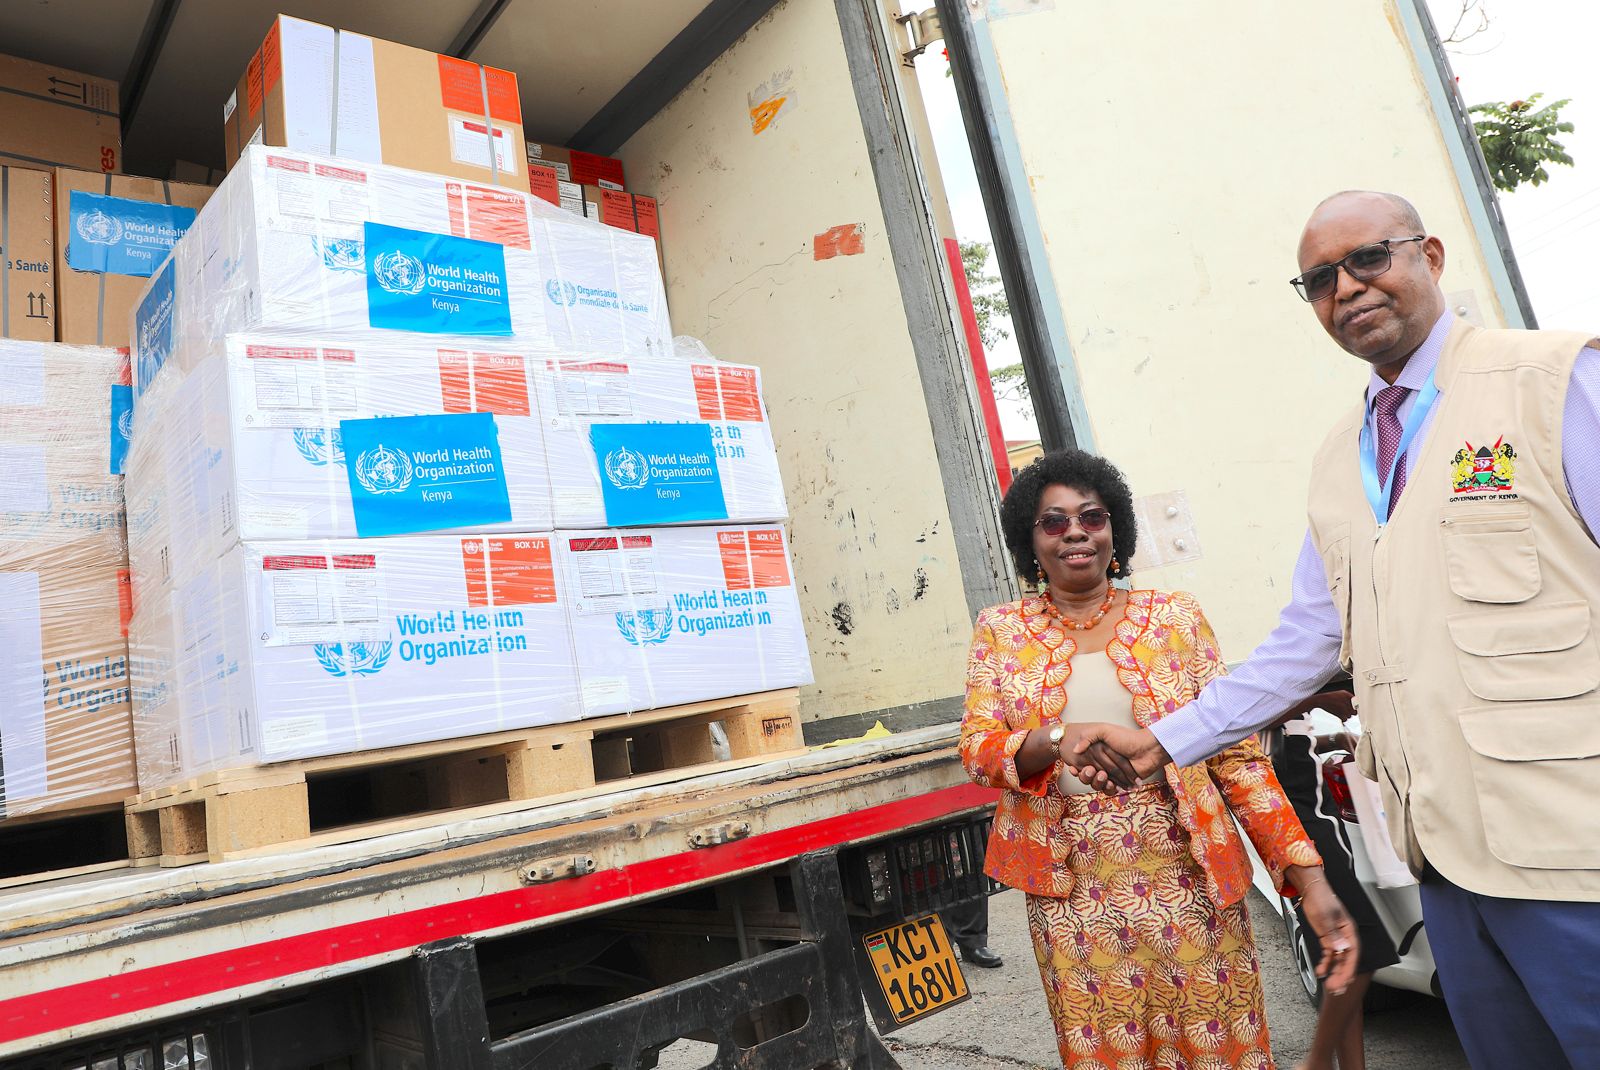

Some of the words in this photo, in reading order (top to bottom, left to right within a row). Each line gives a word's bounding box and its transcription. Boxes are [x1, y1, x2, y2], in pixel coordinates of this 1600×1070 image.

[531, 169, 545, 177] BOX
[124, 221, 155, 234] World
[126, 247, 152, 260] Kenya
[427, 263, 460, 278] World
[464, 269, 500, 284] Health
[427, 276, 501, 297] Organization
[577, 285, 618, 299] Organisatio
[432, 298, 460, 314] Kenya
[412, 450, 450, 465] World
[453, 446, 492, 461] Health
[648, 454, 677, 466] World
[680, 452, 710, 464] Health
[415, 460, 495, 481] Organization
[650, 464, 713, 481] Organization
[422, 489, 453, 504] Kenya
[656, 487, 681, 501] Kenya
[1449, 495, 1487, 503] GOVERNMENT
[514, 541, 531, 549] BOX
[531, 540, 545, 550] 1/1
[756, 533, 769, 541] BOX
[673, 590, 718, 612] World
[396, 610, 456, 636] World
[462, 610, 524, 631] Helth
[55, 656, 126, 683] World
[57, 686, 131, 713] Organ
[884, 916, 941, 969] KCT
[889, 958, 958, 1019] 168V
